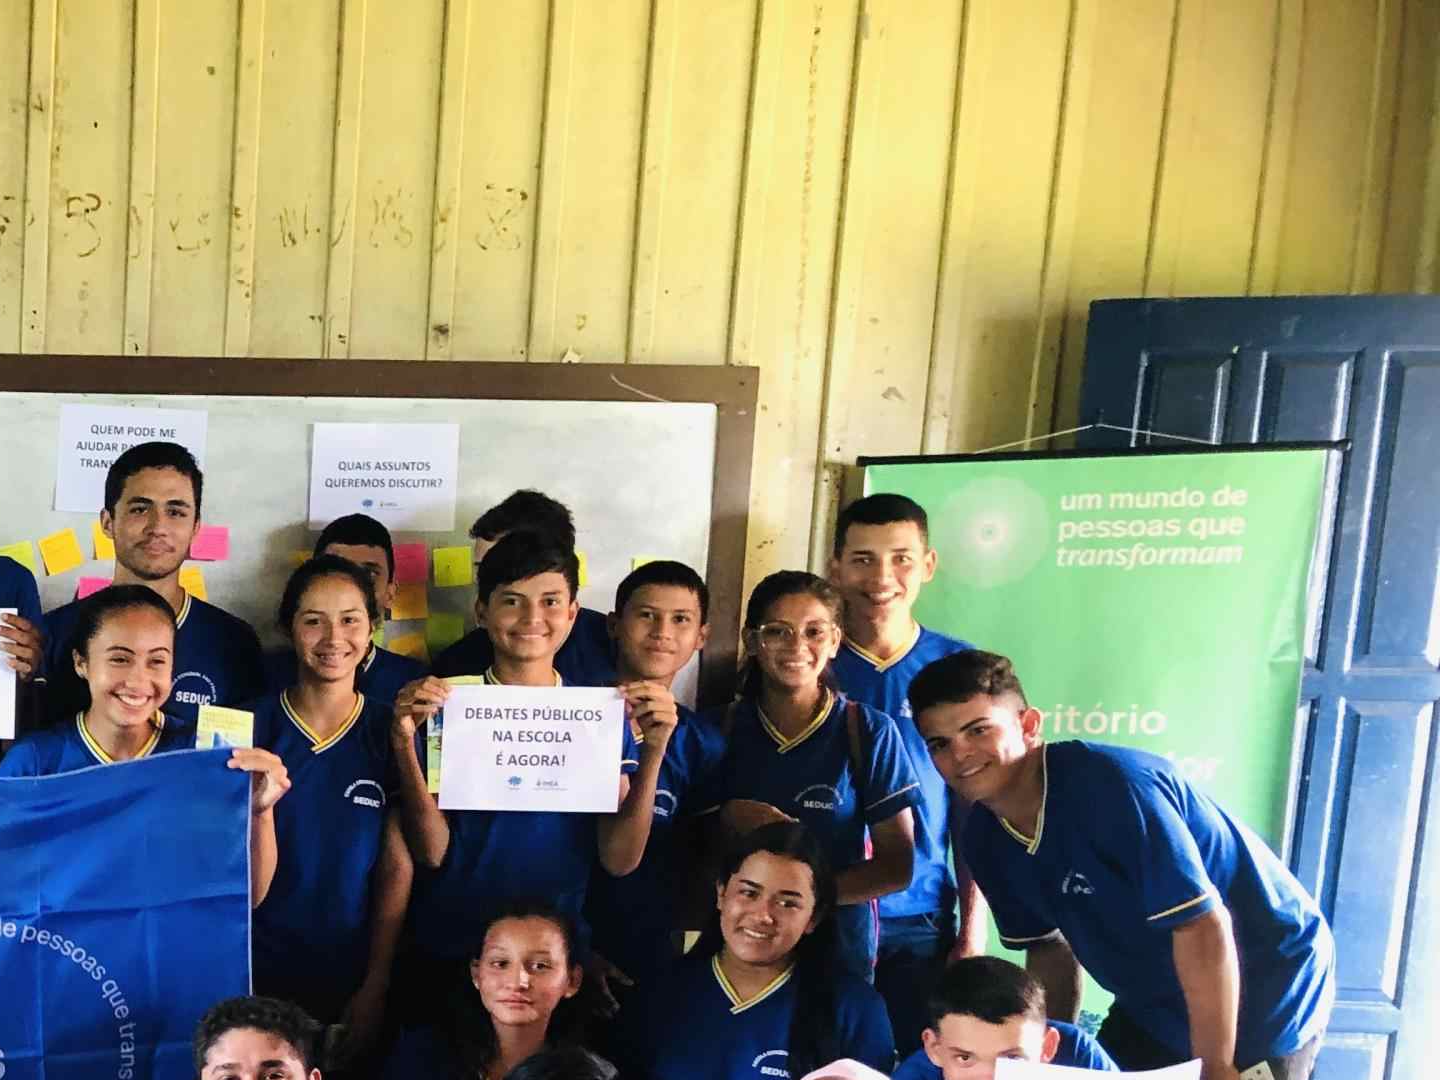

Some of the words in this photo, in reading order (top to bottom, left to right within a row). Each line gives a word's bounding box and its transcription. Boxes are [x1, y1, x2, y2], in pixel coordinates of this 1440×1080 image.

[90, 424, 124, 436] QUEM
[127, 426, 156, 438] PODE
[159, 428, 177, 438] ME
[75, 441, 118, 452] AJUDAR
[338, 461, 372, 472] QUAIS
[374, 461, 432, 472] ASSUNTOS
[324, 478, 386, 488] QUEREMOS
[388, 478, 443, 489] DISCUTIR?
[1060, 492, 1104, 511] um
[1108, 487, 1205, 509] mundo
[1211, 484, 1249, 507] de
[1057, 517, 1181, 543] pessoas
[1187, 515, 1247, 540] que
[1055, 542, 1244, 571] transformam
[175, 690, 211, 705] SEDUC
[464, 707, 528, 721] DEBATES
[532, 705, 603, 722] PÚBLICOS
[1040, 702, 1168, 736] ritório
[492, 730, 513, 743] NA
[517, 731, 572, 743] ESCOLA
[495, 751, 503, 766] É
[507, 754, 566, 767] AGORA!
[20, 924, 106, 981] pessoas
[101, 979, 130, 1020] que
